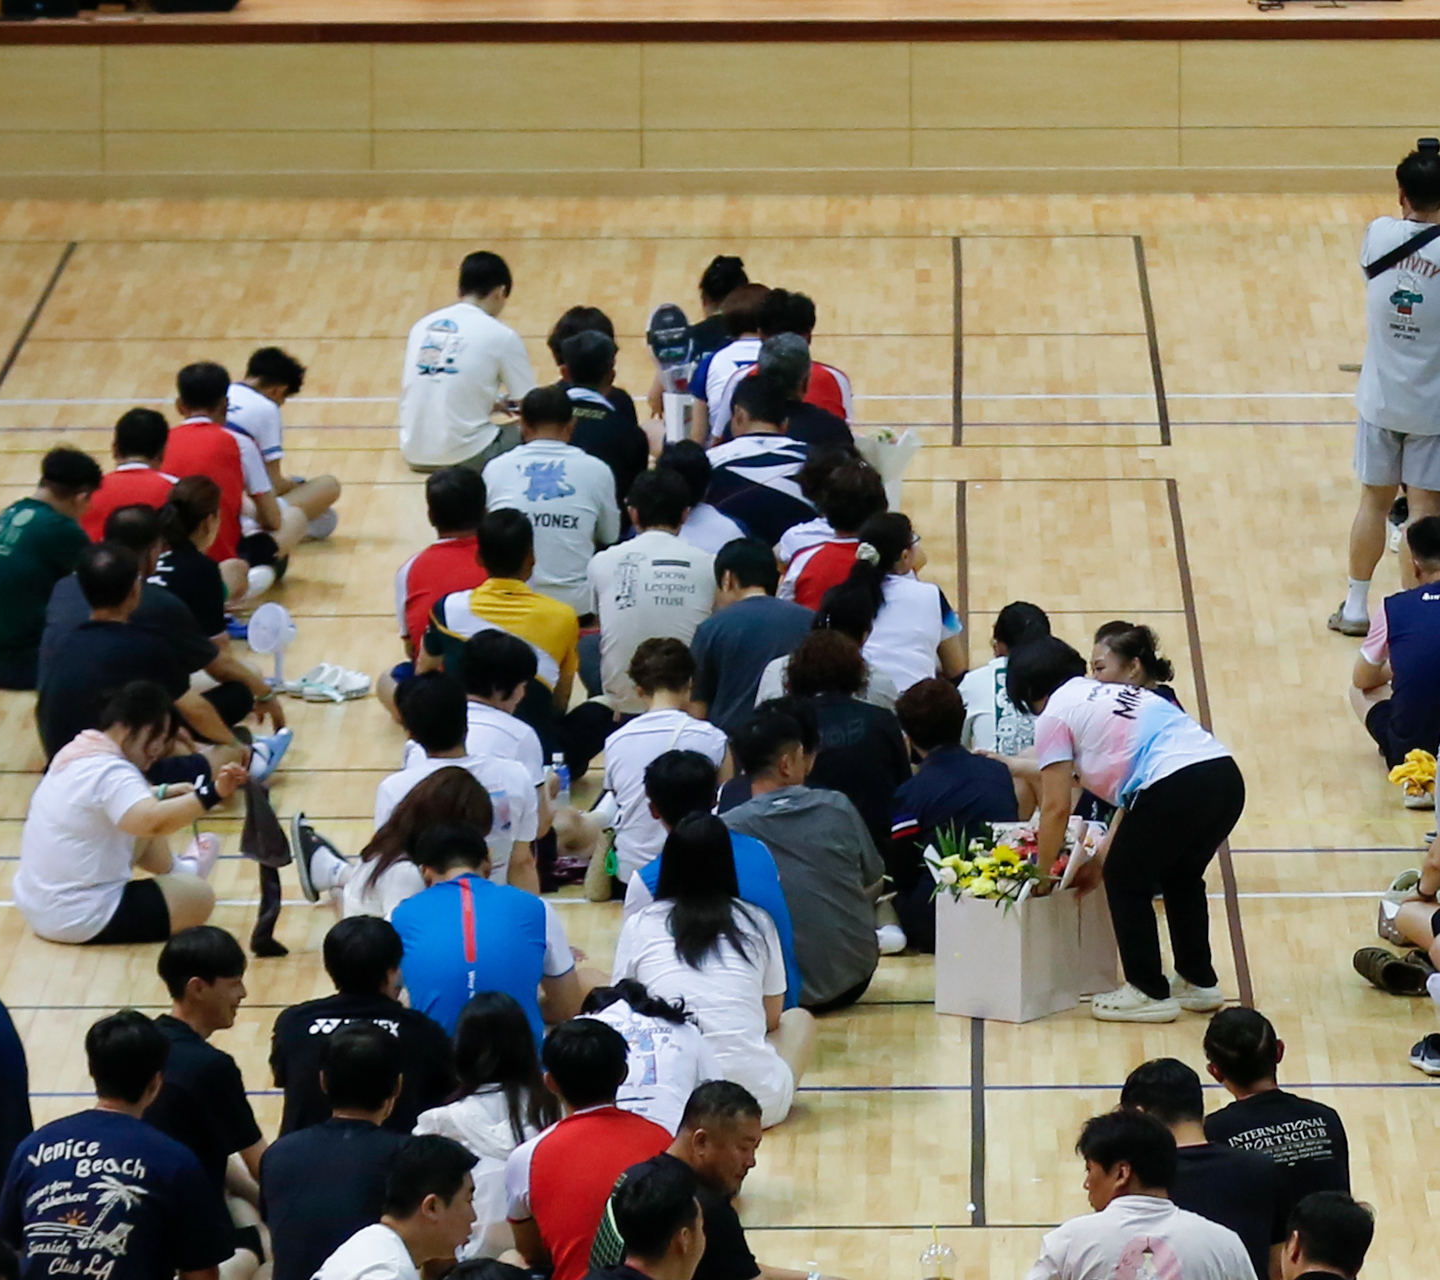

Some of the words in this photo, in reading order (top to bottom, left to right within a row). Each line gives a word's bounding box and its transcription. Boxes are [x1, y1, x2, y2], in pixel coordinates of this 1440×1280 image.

[532, 512, 580, 530] YONEX
[653, 570, 688, 581] Snow
[644, 581, 696, 594] Leopard
[654, 595, 685, 607] Trust
[1227, 1117, 1328, 1150] INTERNATIONAL
[26, 1138, 102, 1168] Venice
[74, 1155, 147, 1181] Beach
[26, 1239, 72, 1258] Seaside
[47, 1256, 82, 1276] Club
